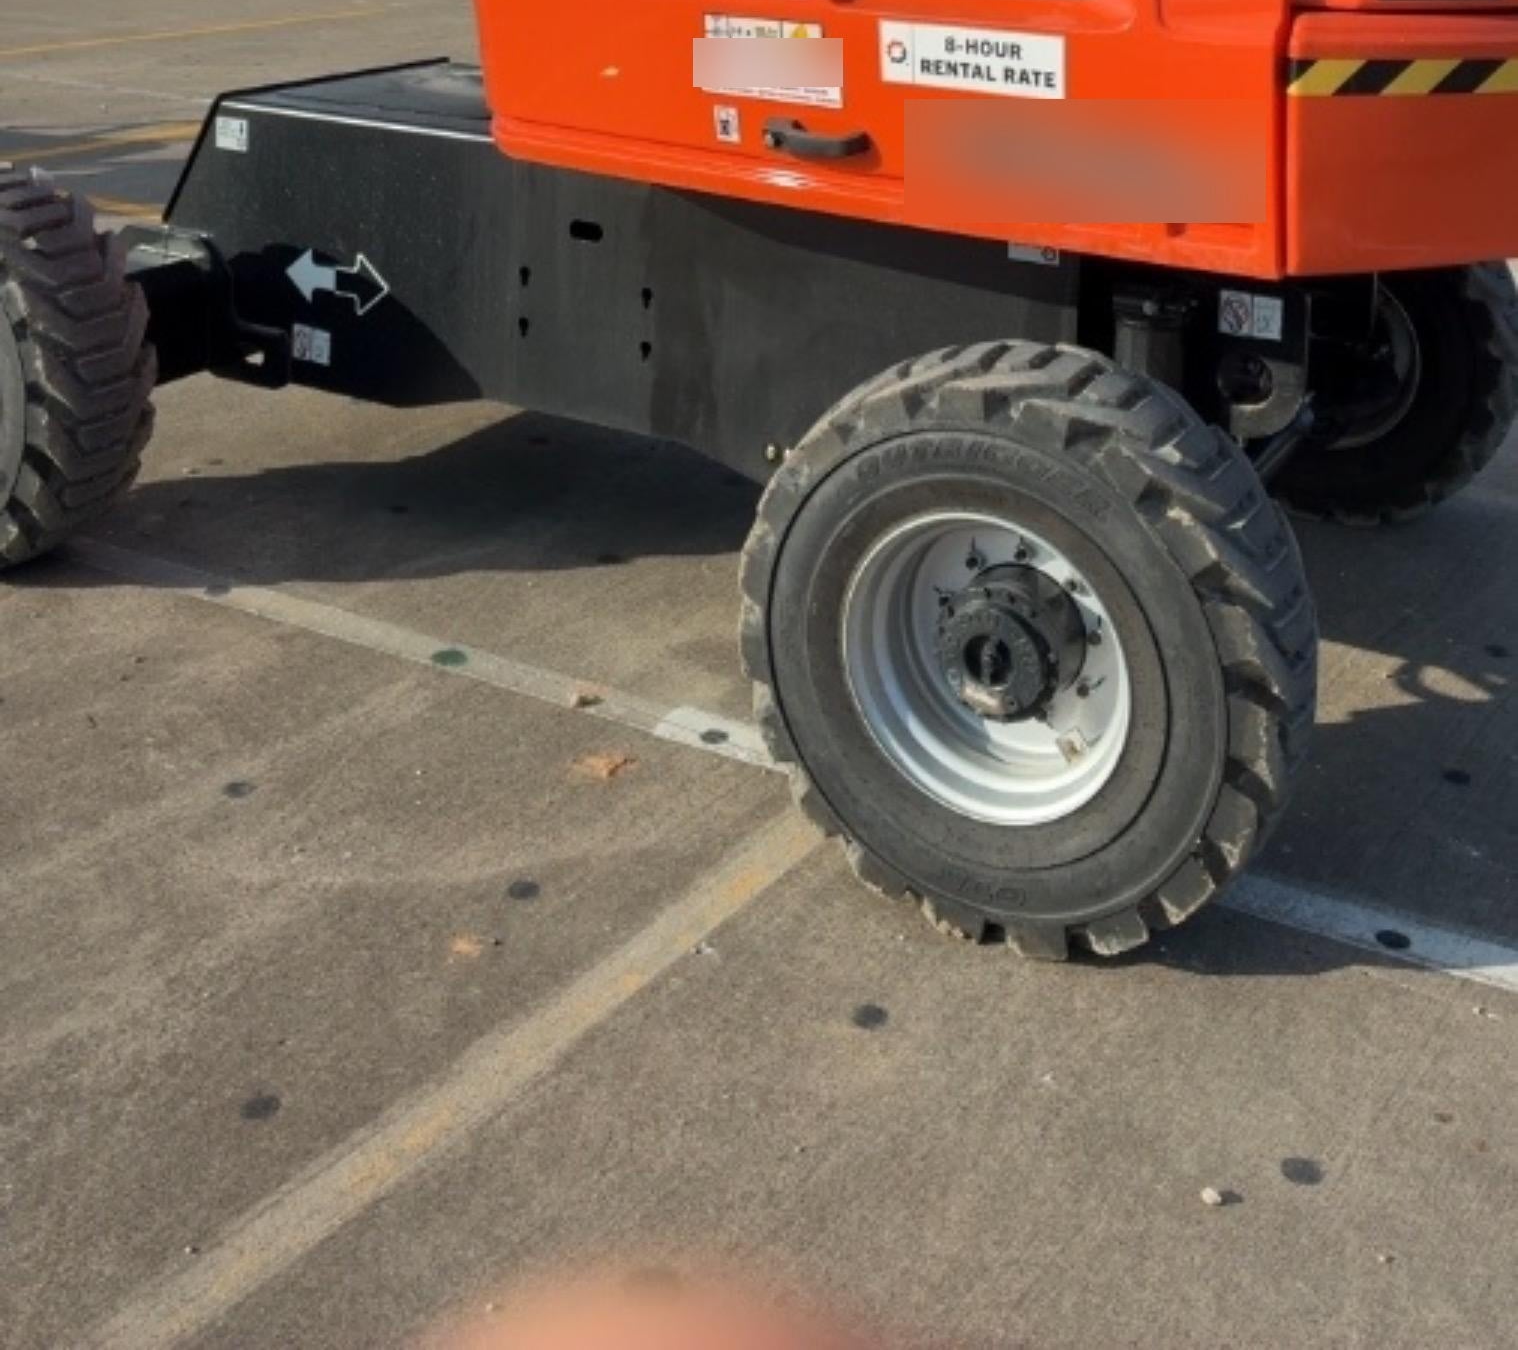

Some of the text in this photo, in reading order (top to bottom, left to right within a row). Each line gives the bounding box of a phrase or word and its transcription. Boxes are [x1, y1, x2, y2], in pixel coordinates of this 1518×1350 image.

[944, 36, 1022, 61] 8-HOUR
[920, 58, 1057, 89] RENTAL RATE
